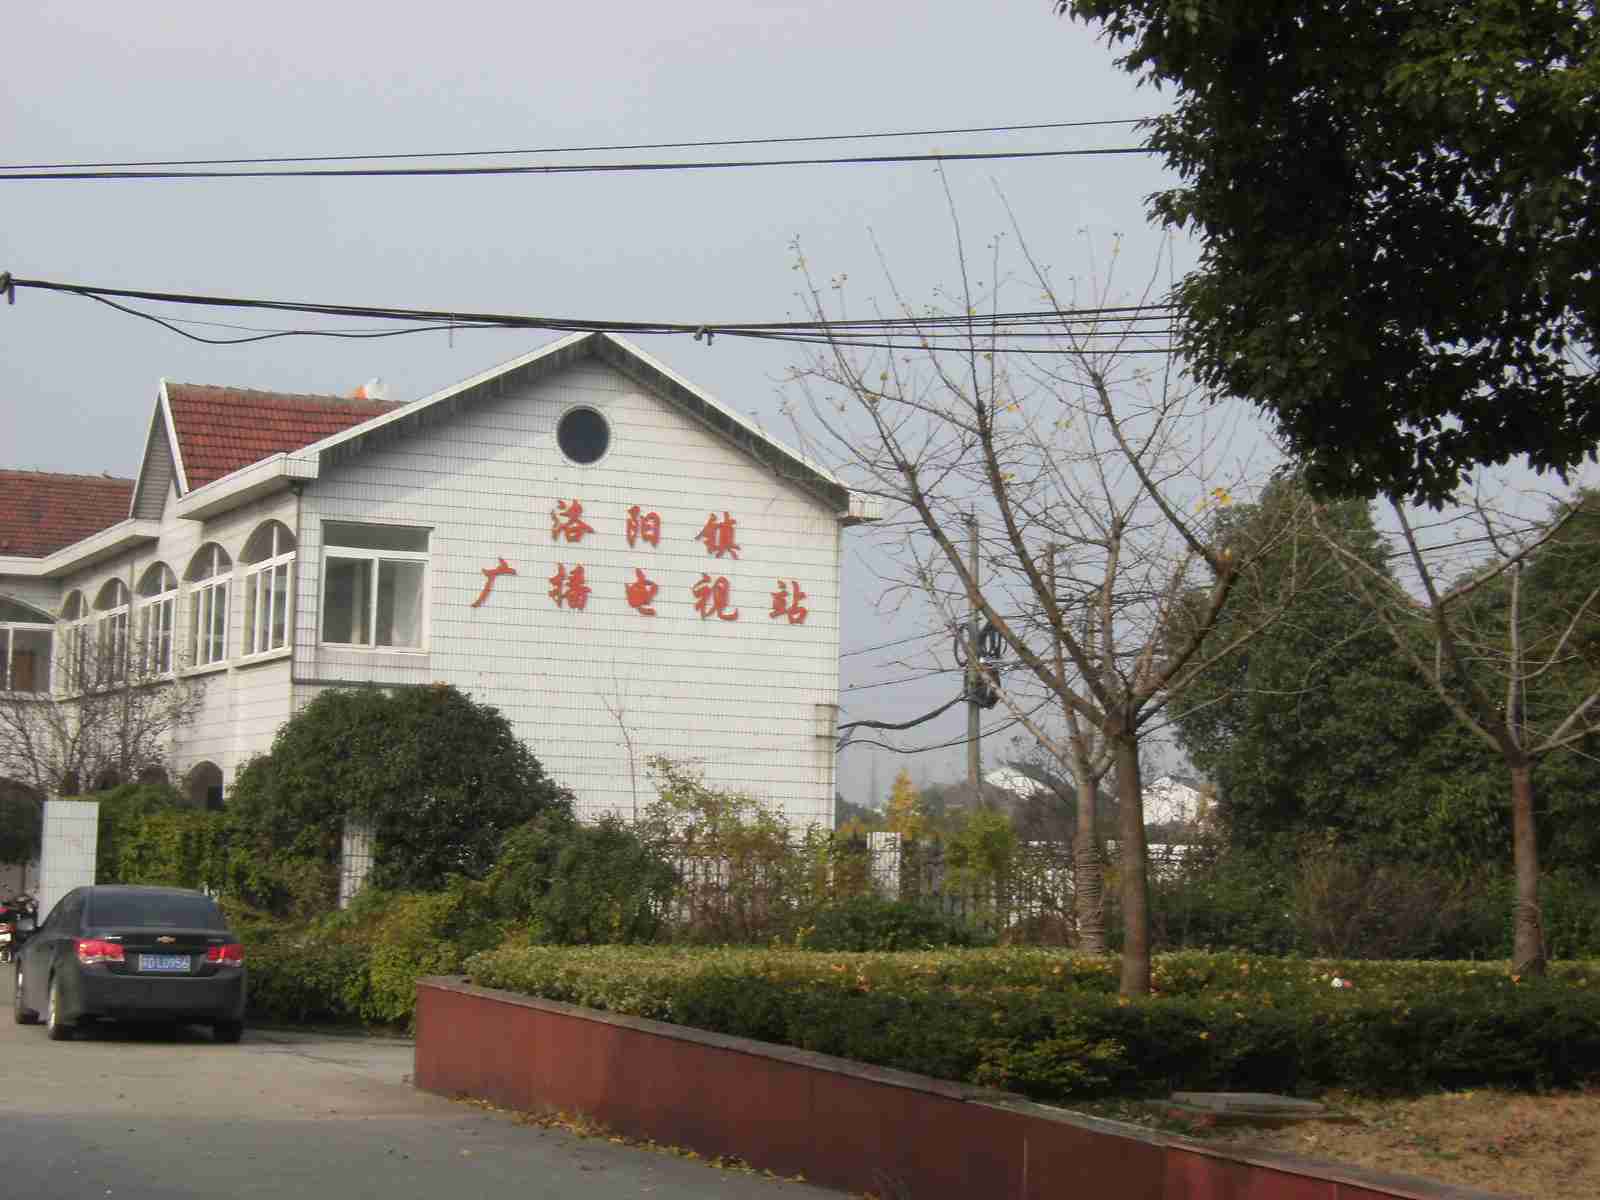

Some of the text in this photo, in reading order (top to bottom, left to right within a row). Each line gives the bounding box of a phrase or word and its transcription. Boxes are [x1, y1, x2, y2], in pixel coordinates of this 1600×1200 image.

[550, 498, 740, 560] 洛阳镇
[471, 557, 808, 624] 广播电视站
